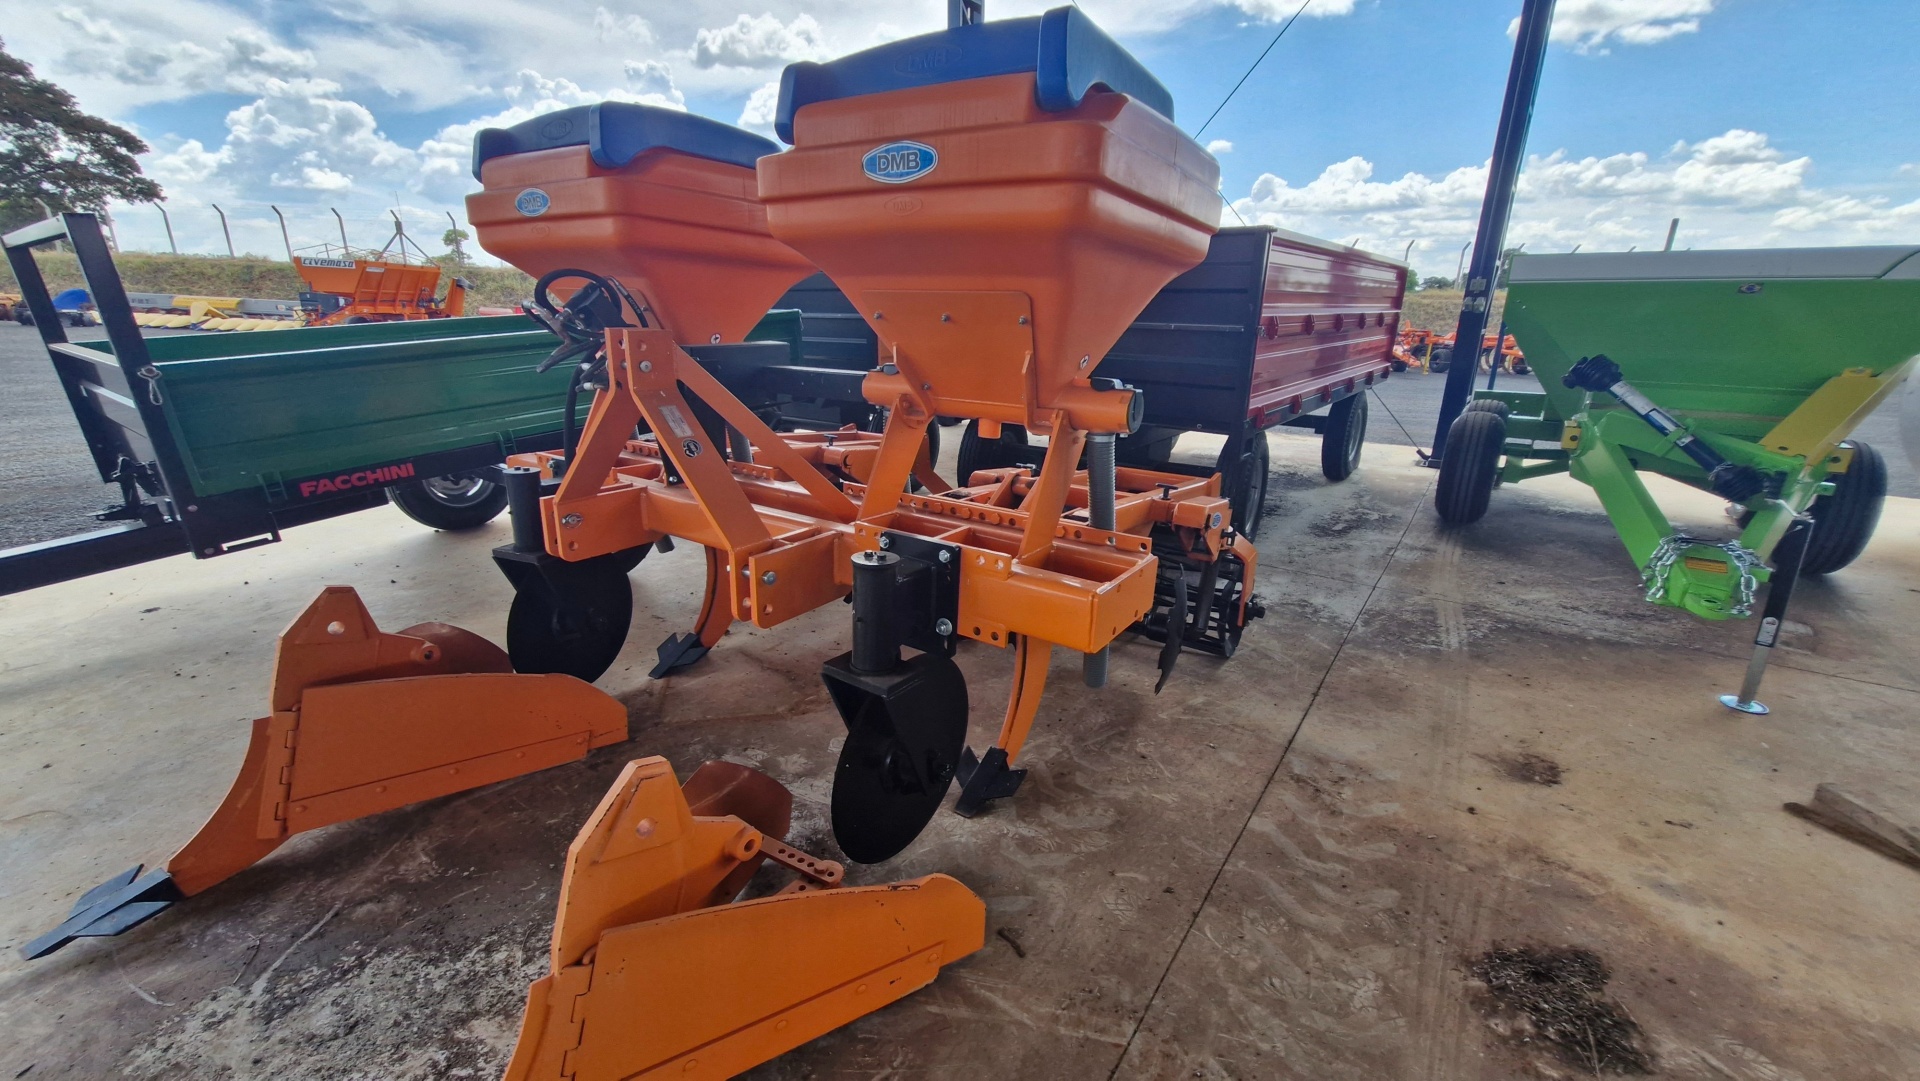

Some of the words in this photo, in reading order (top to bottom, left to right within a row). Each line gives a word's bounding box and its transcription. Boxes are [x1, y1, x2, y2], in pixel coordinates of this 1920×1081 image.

[876, 150, 921, 174] DMB
[521, 195, 543, 210] DMB
[299, 462, 415, 498] FACCHINI
